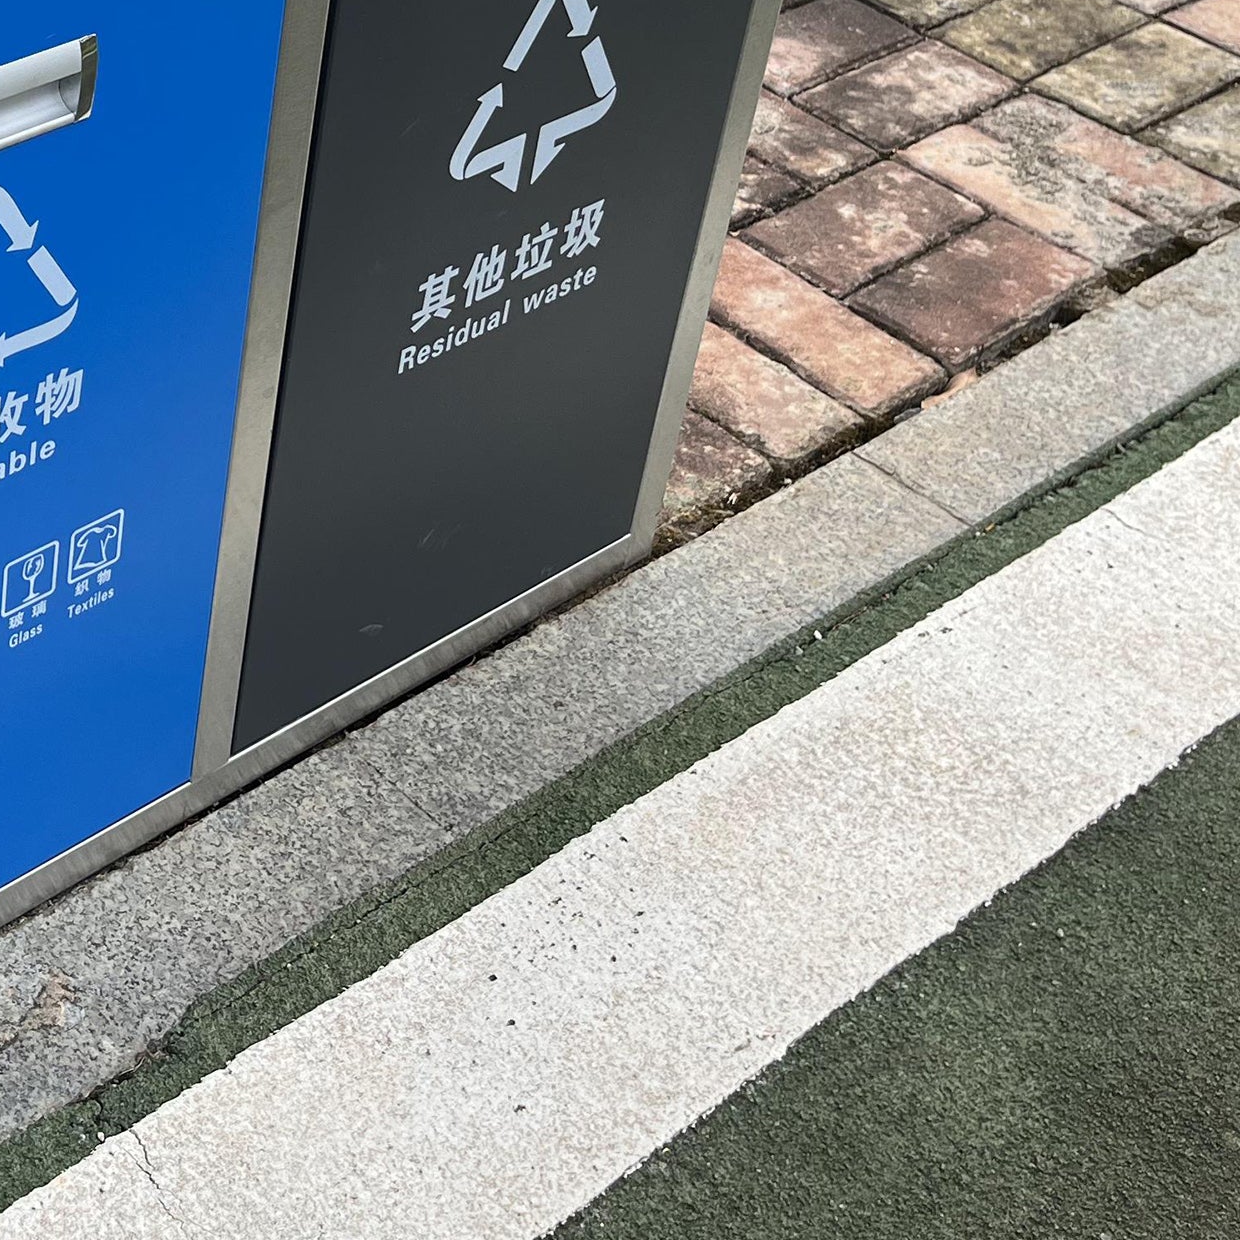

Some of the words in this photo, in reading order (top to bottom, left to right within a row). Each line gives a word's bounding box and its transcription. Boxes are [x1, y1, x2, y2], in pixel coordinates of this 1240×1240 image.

[410, 198, 605, 333] 其他垃圾
[397, 299, 511, 375] Residual
[523, 265, 597, 314] waste
[8, 623, 43, 648] Glass
[66, 587, 115, 618] Textiles
